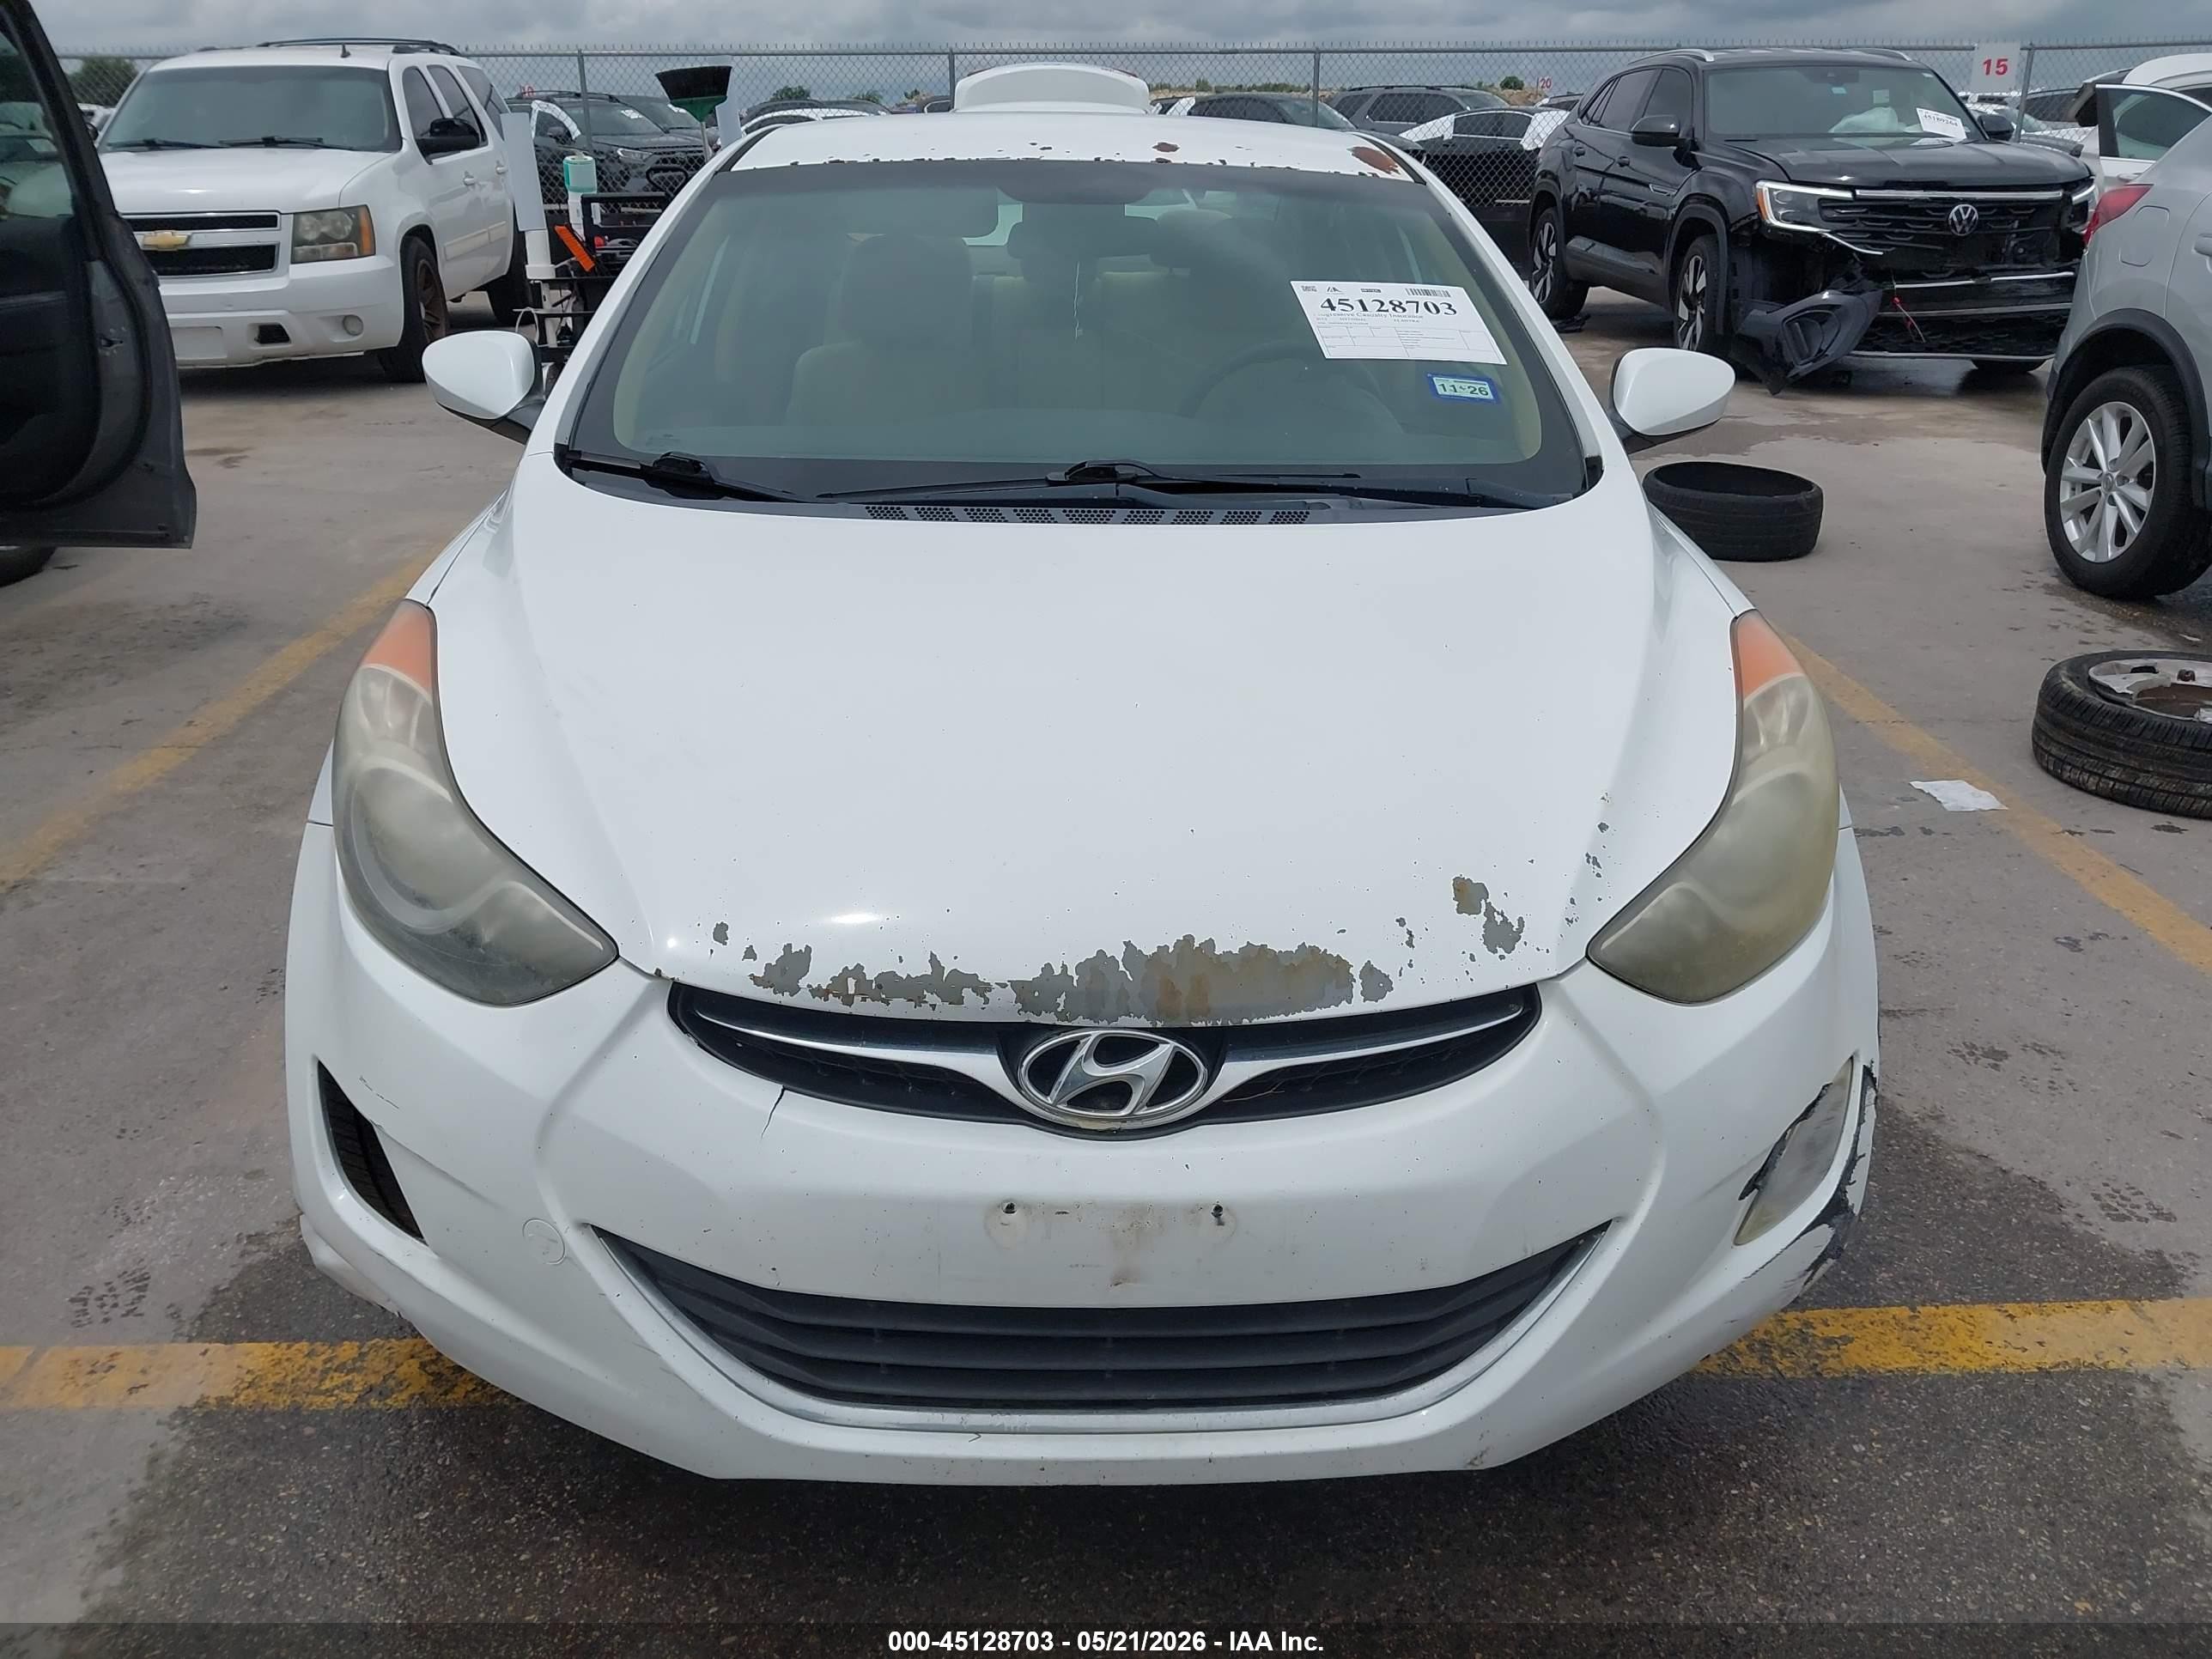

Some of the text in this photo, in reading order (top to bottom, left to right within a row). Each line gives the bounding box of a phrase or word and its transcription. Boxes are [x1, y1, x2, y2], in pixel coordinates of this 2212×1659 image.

[1984, 58, 2008, 76] 15
[1540, 77, 1552, 89] 20
[1321, 298, 1457, 316] 45128703
[1468, 386, 1488, 396] 26
